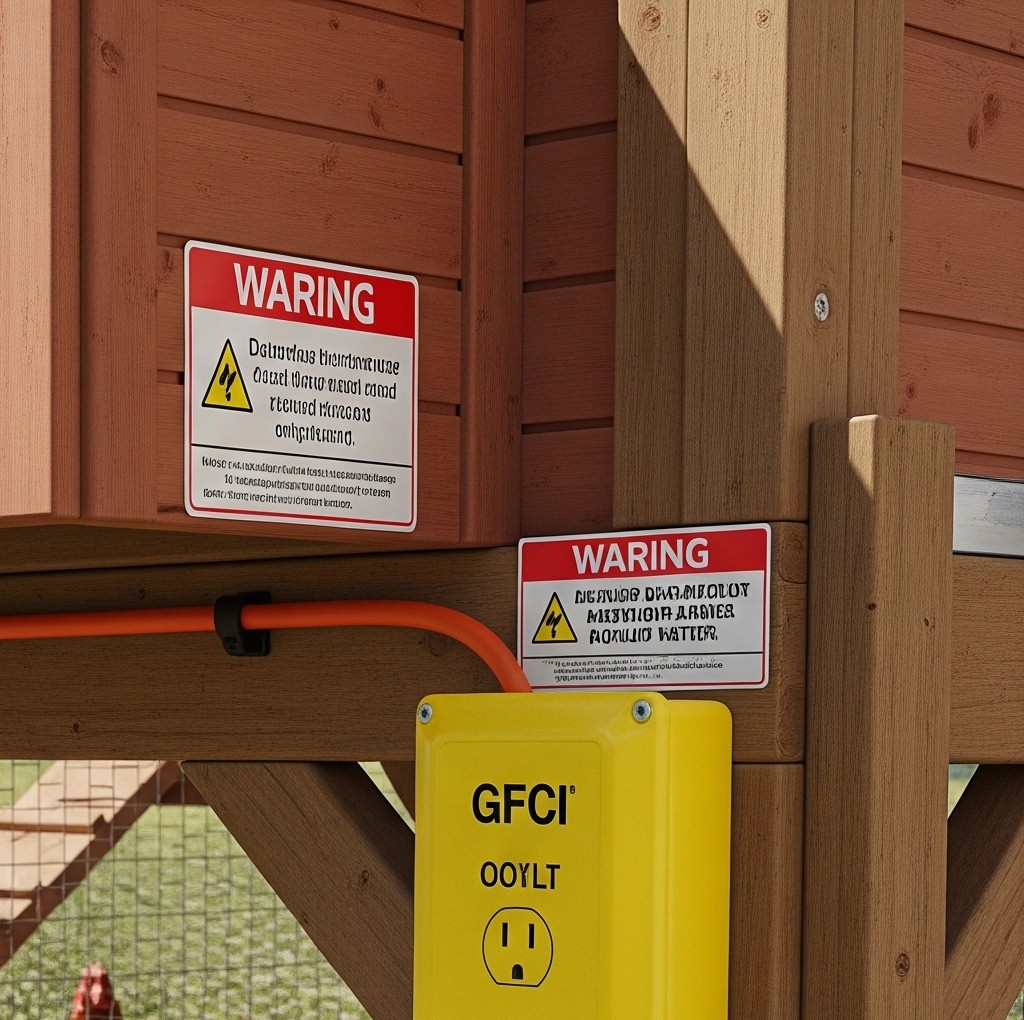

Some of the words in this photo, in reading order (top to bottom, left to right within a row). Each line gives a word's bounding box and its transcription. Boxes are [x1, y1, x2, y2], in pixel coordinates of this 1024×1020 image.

[233, 262, 375, 325] WARING
[572, 537, 709, 575] WARING
[472, 783, 567, 826] GFCI
